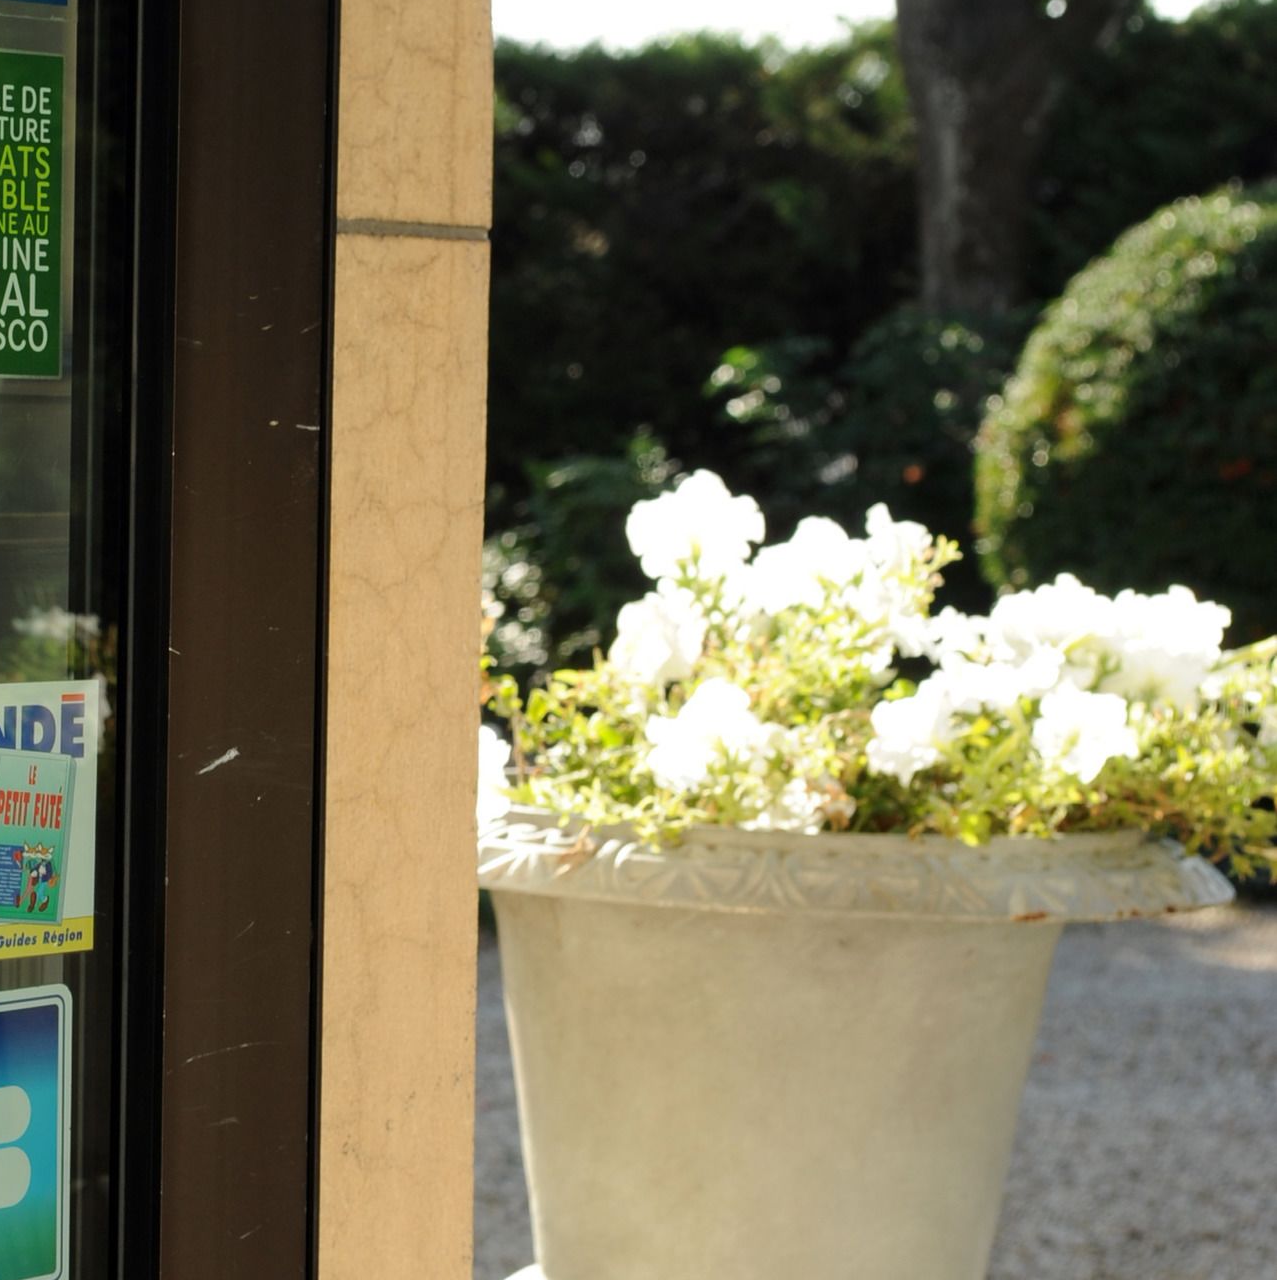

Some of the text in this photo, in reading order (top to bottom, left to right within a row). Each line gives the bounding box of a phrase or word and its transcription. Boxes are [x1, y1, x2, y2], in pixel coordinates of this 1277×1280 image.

[21, 86, 52, 115] DE
[22, 212, 49, 236] AU
[43, 928, 83, 947] Région
